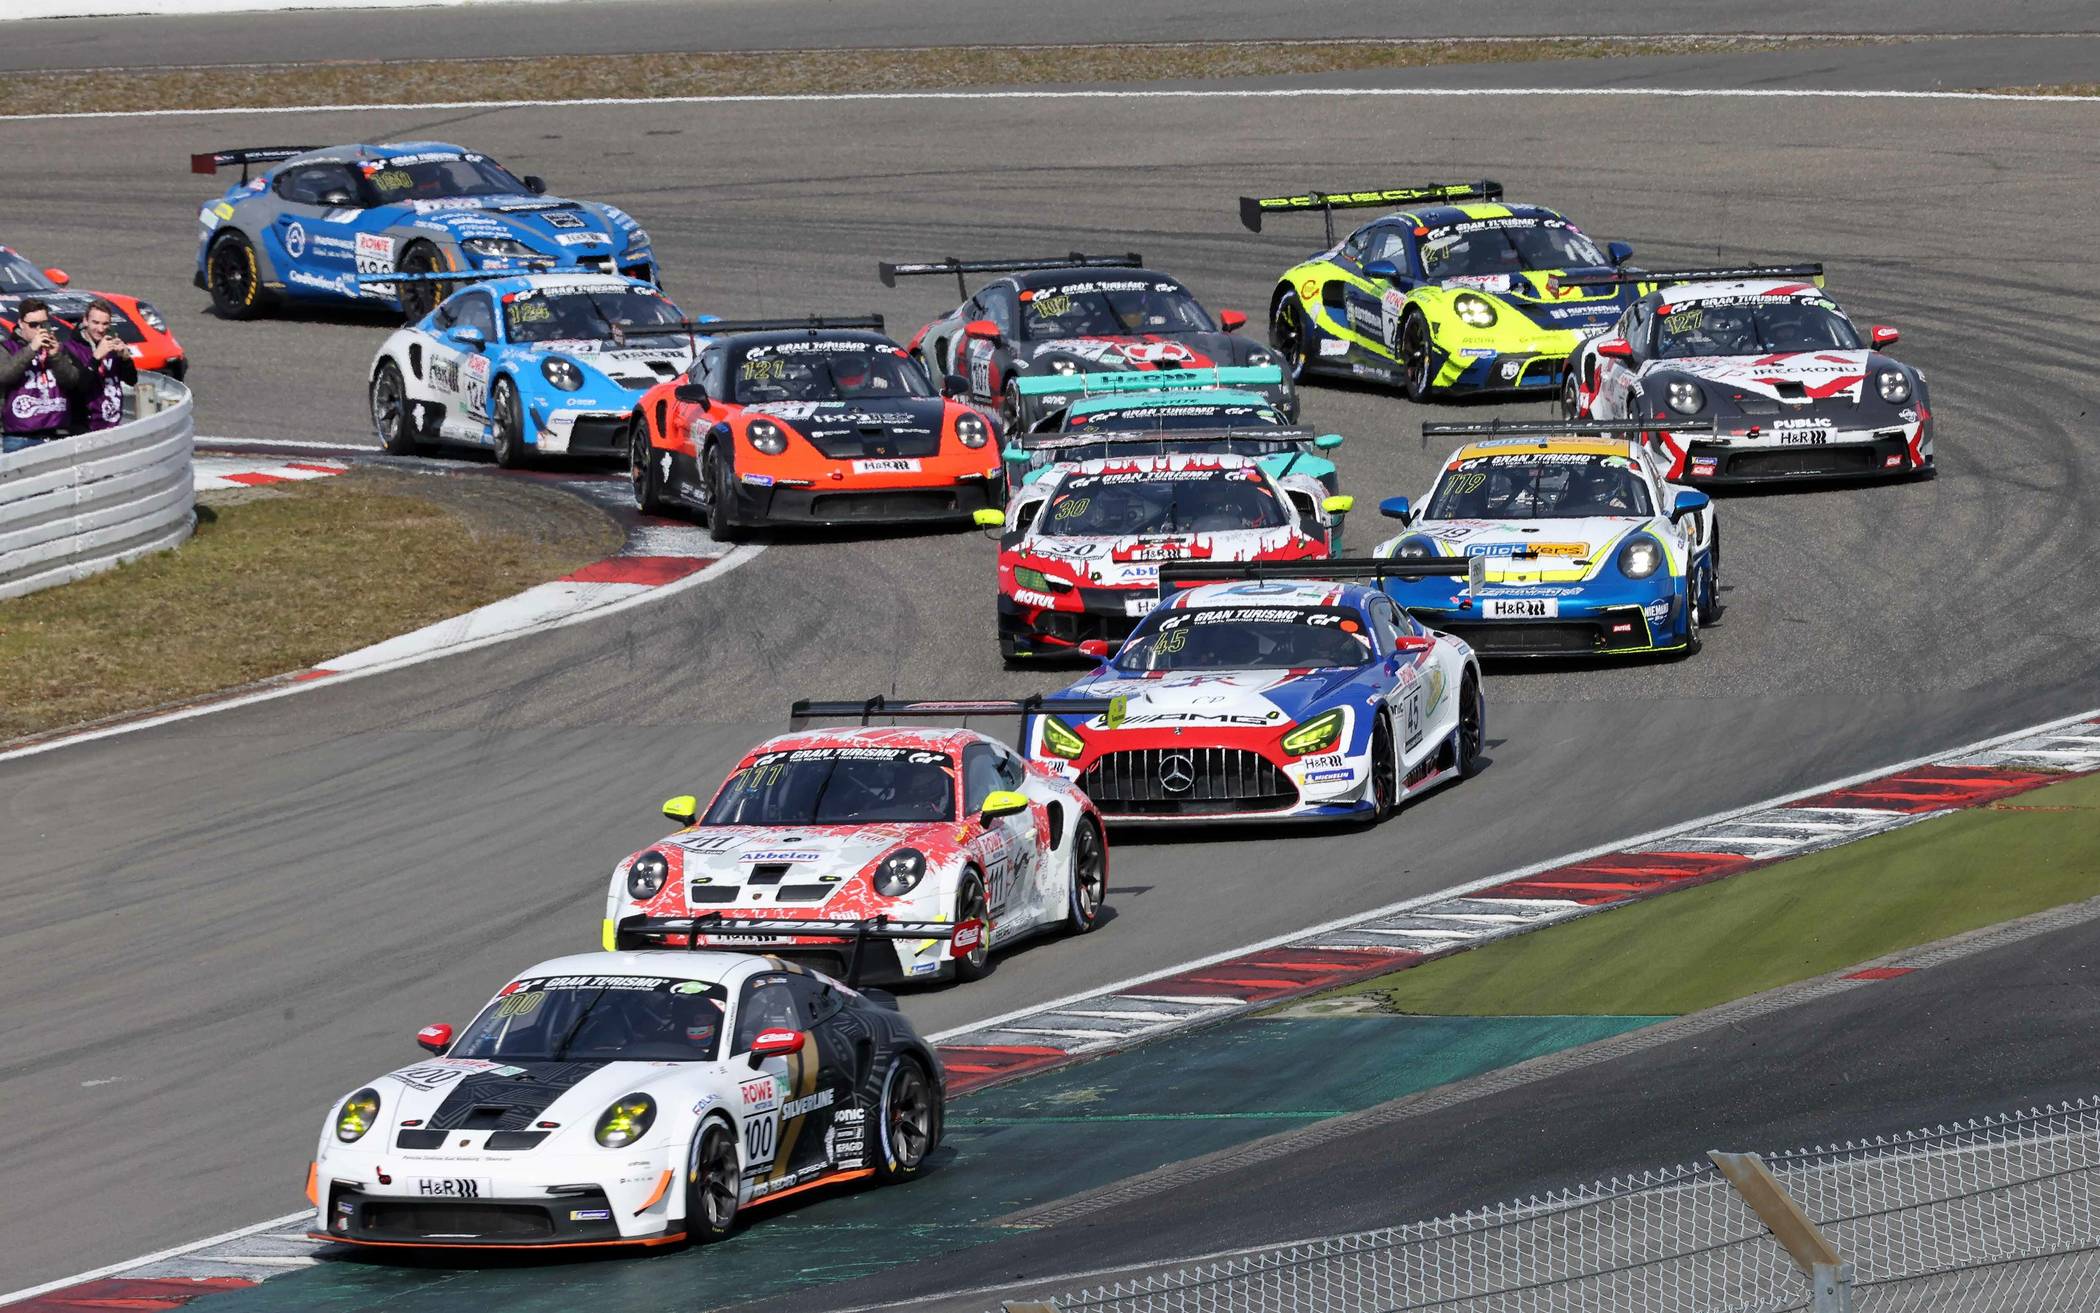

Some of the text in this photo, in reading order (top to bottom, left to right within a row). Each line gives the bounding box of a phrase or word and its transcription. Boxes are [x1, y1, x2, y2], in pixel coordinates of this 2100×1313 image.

[1701, 297, 1735, 308] GRAN
[1664, 310, 1703, 334] 127
[776, 342, 810, 353] GRAN
[743, 361, 786, 381] 121
[1121, 408, 1157, 418] GRAN
[1773, 418, 1832, 429] PUBLIC
[1781, 431, 1808, 444] H&R
[1491, 455, 1531, 464] GRAN
[863, 461, 894, 474] H&R
[1102, 473, 1143, 483] GRAN
[1442, 473, 1487, 496] 119
[1055, 498, 1091, 520] 30
[1140, 549, 1165, 559] H&R
[1471, 545, 1523, 556] Click
[1014, 589, 1056, 610] MOTUL
[1495, 601, 1525, 615] H&R
[1194, 609, 1234, 622] GRAN
[1153, 629, 1189, 655] 45
[1152, 712, 1268, 726] AMG
[1407, 694, 1419, 733] 45
[789, 748, 830, 759] GRAN
[1305, 756, 1328, 769] H&R
[735, 763, 784, 792] 111
[1314, 771, 1349, 781] MICHELIN
[740, 851, 820, 861] Abbelen
[543, 976, 590, 988] GRAN
[494, 991, 546, 1019] 100
[741, 1081, 773, 1104] ROWE
[782, 1088, 836, 1120] SILVERLINE
[834, 1108, 865, 1122] SONIC
[745, 1116, 773, 1160] 100
[419, 1179, 455, 1196] H&R
